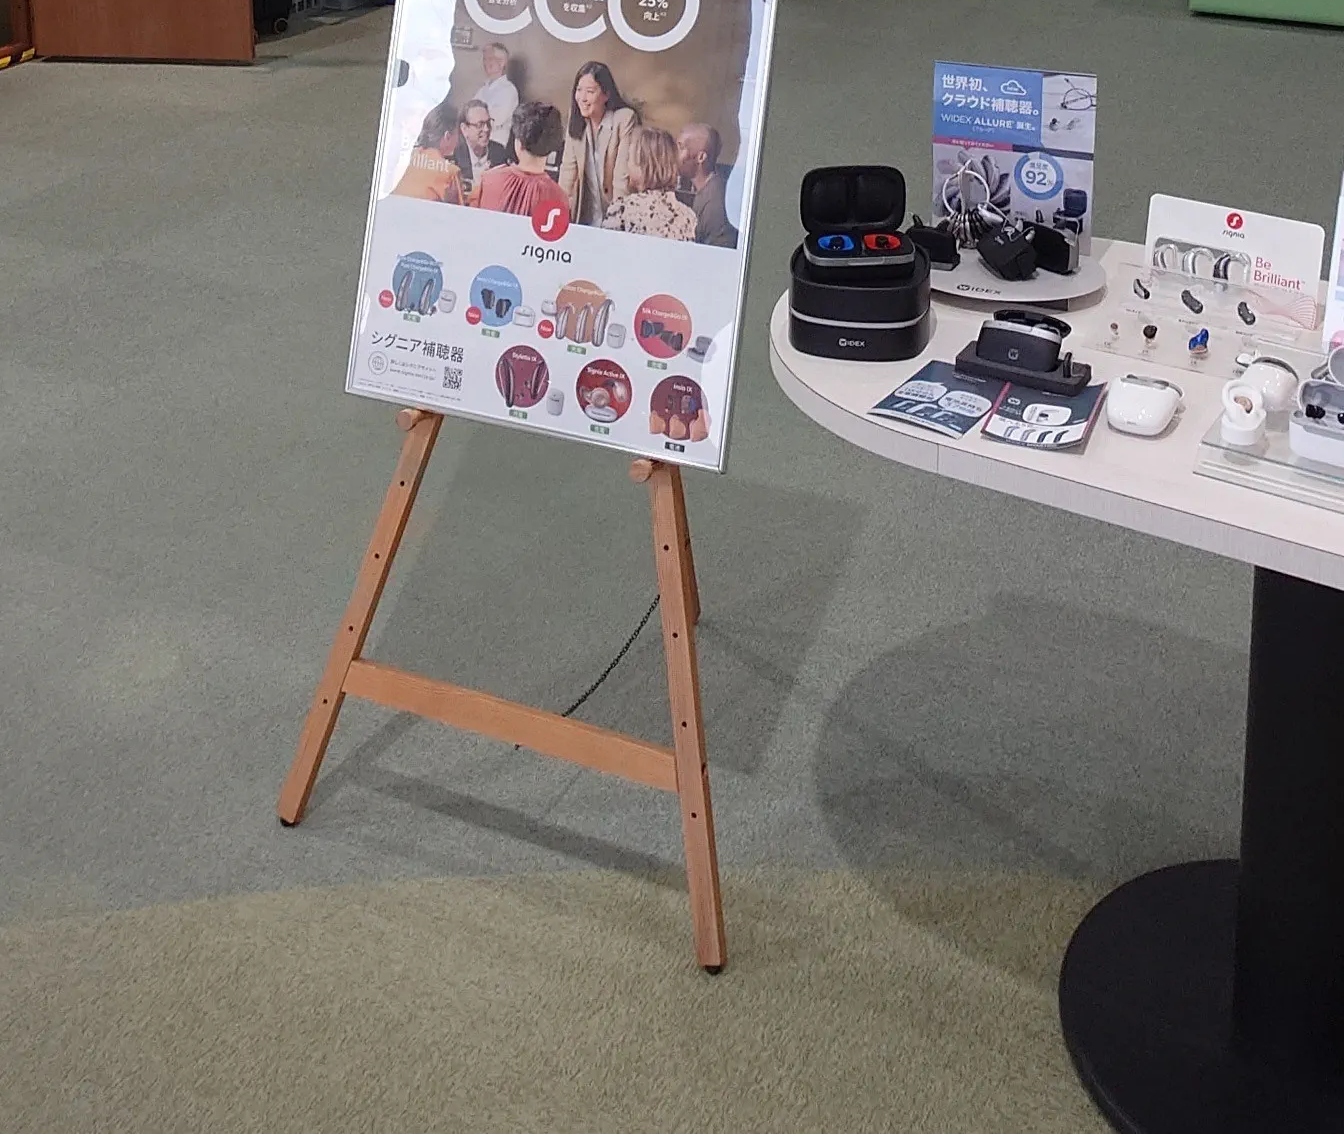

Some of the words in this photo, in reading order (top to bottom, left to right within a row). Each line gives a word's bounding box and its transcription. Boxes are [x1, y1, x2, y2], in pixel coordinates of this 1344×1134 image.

[643, 11, 660, 22] 向上
[941, 74, 989, 92] 世界初、
[941, 93, 1040, 116] クラウド補聴器。
[940, 113, 971, 124] WIDEX
[974, 117, 1013, 128] ALLURE
[1222, 229, 1245, 239] signia
[521, 244, 572, 265] signia
[1255, 256, 1272, 270] Be
[1253, 269, 1302, 291] Brilliant
[956, 283, 1001, 295] WIDEX
[371, 330, 464, 364] シグニア補聴器
[838, 337, 865, 348] WIDEX
